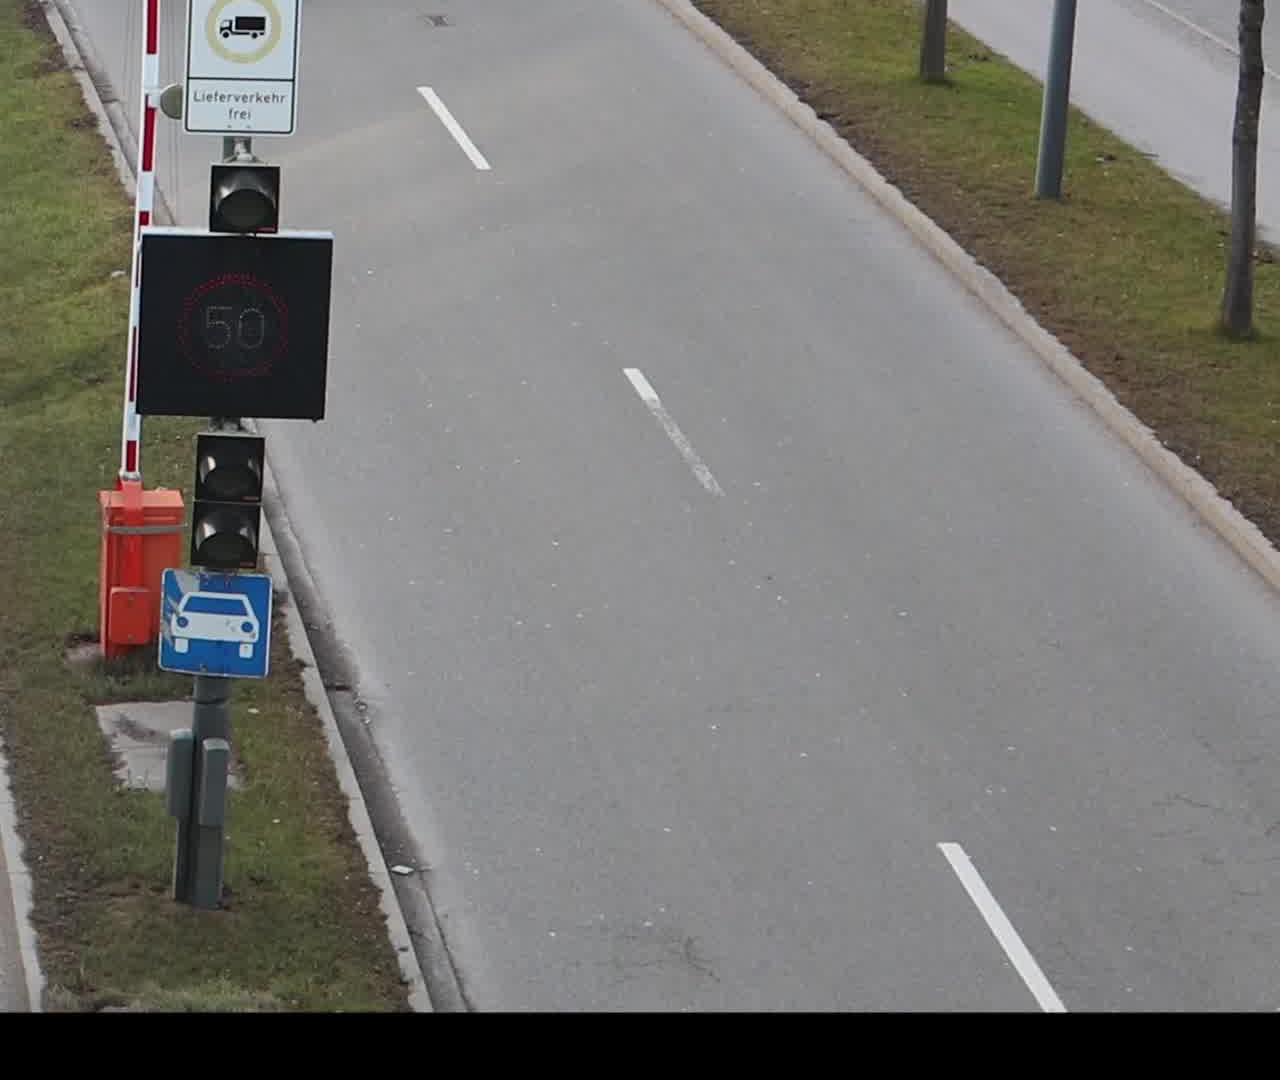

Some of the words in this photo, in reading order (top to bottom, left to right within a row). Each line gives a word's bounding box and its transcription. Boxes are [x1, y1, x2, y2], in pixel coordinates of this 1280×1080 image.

[193, 89, 285, 104] Lieferverkehr
[228, 107, 252, 120] frei
[205, 306, 265, 350] 50
